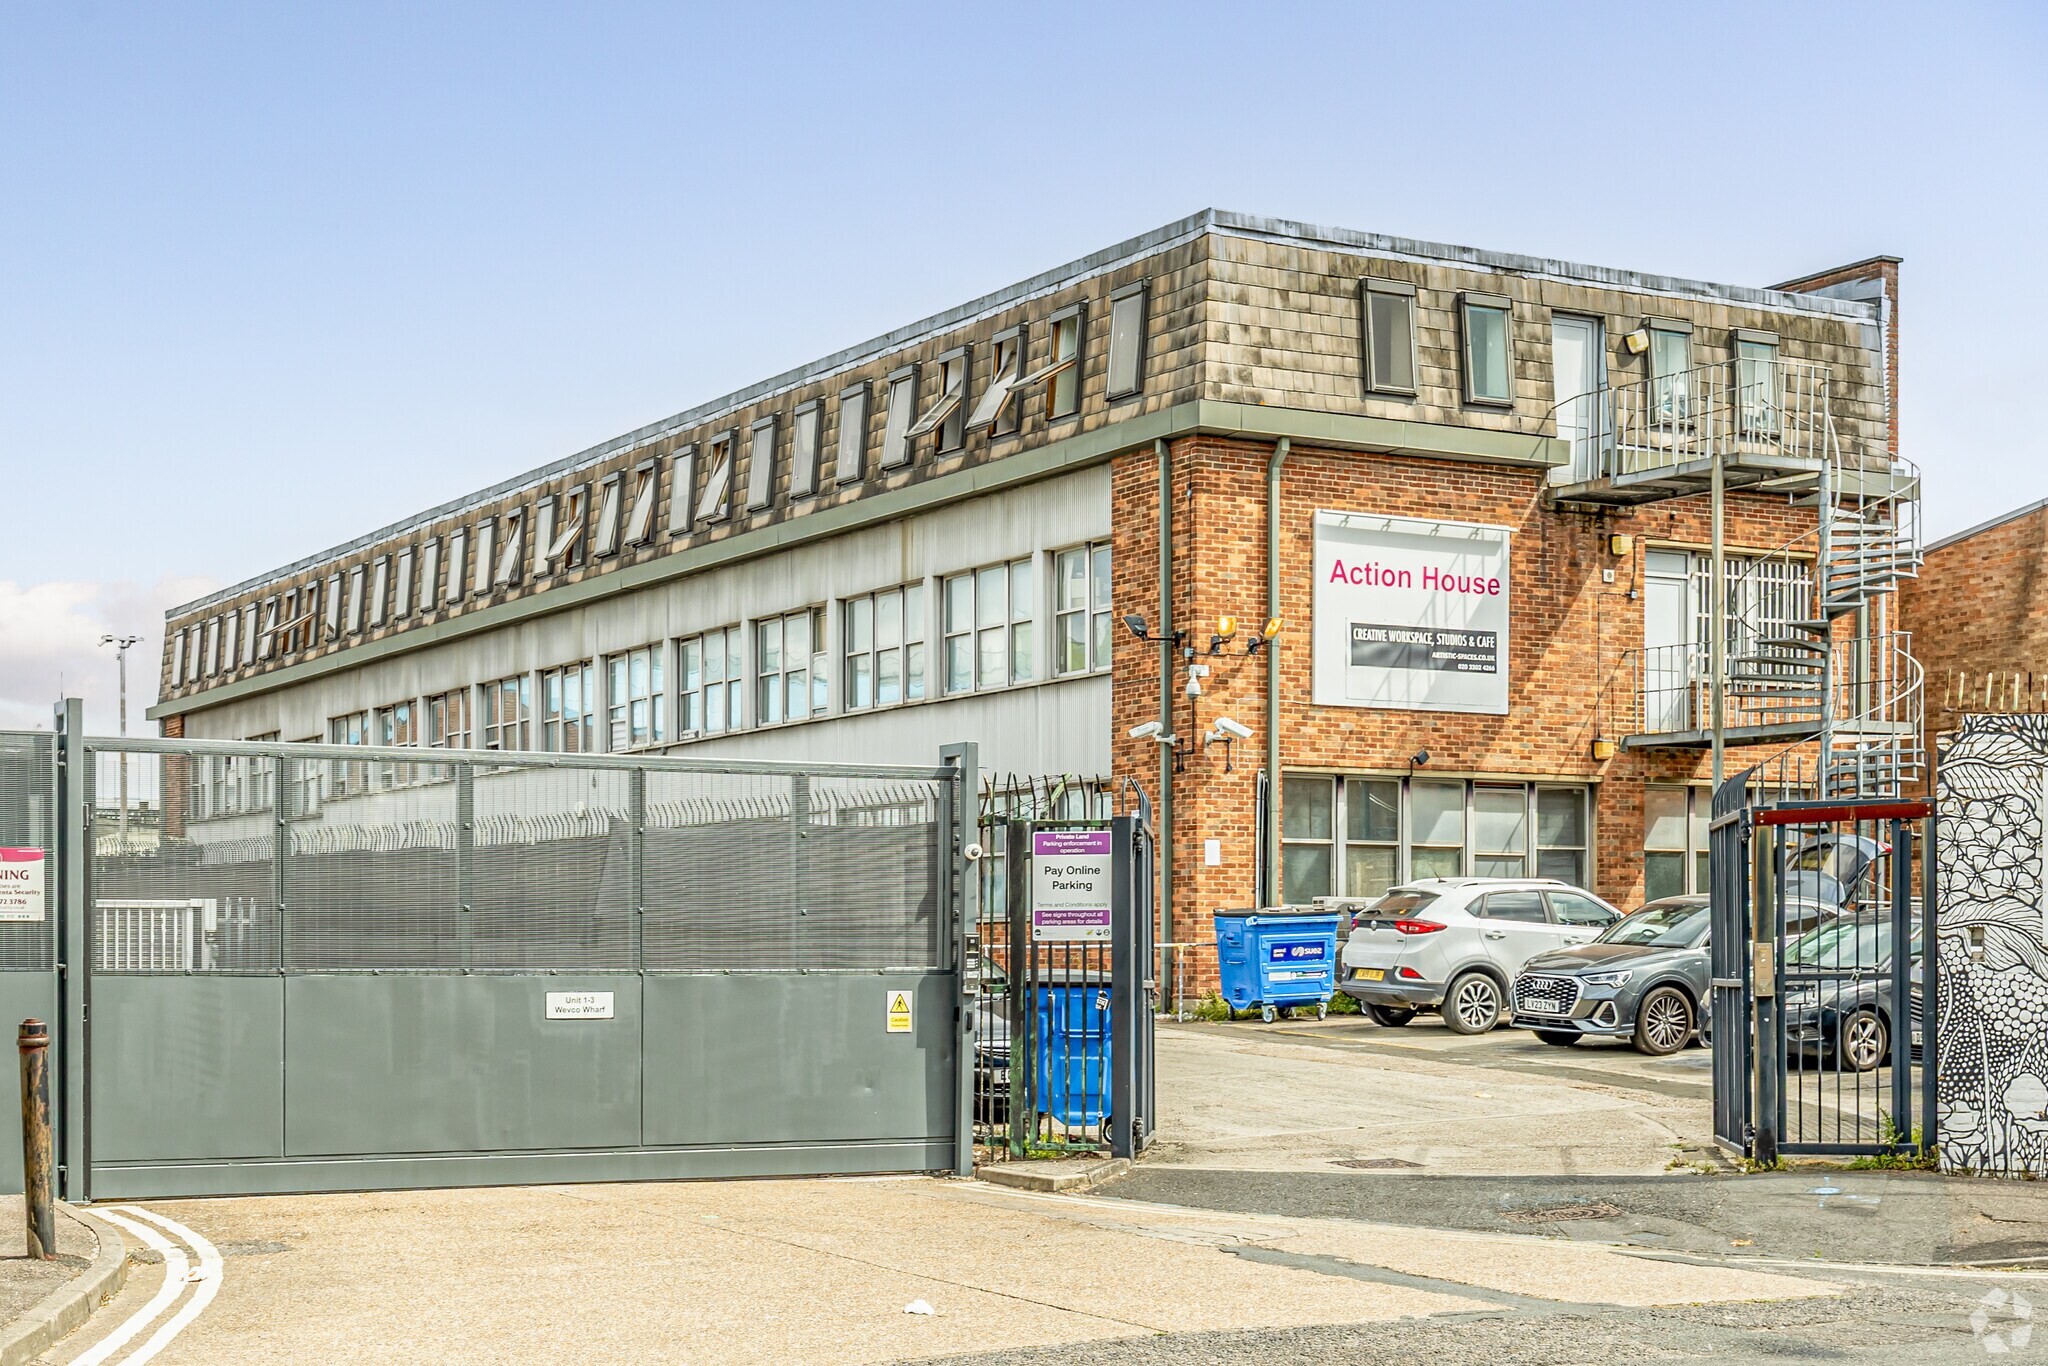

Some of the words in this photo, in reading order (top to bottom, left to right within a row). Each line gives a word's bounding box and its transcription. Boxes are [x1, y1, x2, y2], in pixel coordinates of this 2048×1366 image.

[1329, 559, 1412, 588] Action
[1422, 566, 1501, 596] House
[1353, 628, 1388, 642] CREATIVE
[1388, 630, 1435, 647] WORKSPACE,
[1436, 633, 1468, 647] STUDIOS
[1468, 636, 1476, 647] &
[1476, 635, 1495, 648] CAFE
[1044, 866, 1063, 877] Pay
[1066, 865, 1101, 876] Online
[1052, 880, 1093, 892] Parking
[14, 889, 41, 897] Security
[1053, 911, 1067, 919] signs
[1067, 911, 1097, 919] throughout
[1304, 946, 1323, 955] suez
[565, 996, 582, 1004] Unit
[583, 996, 595, 1004] 1-3
[582, 1005, 606, 1013] Wharf
